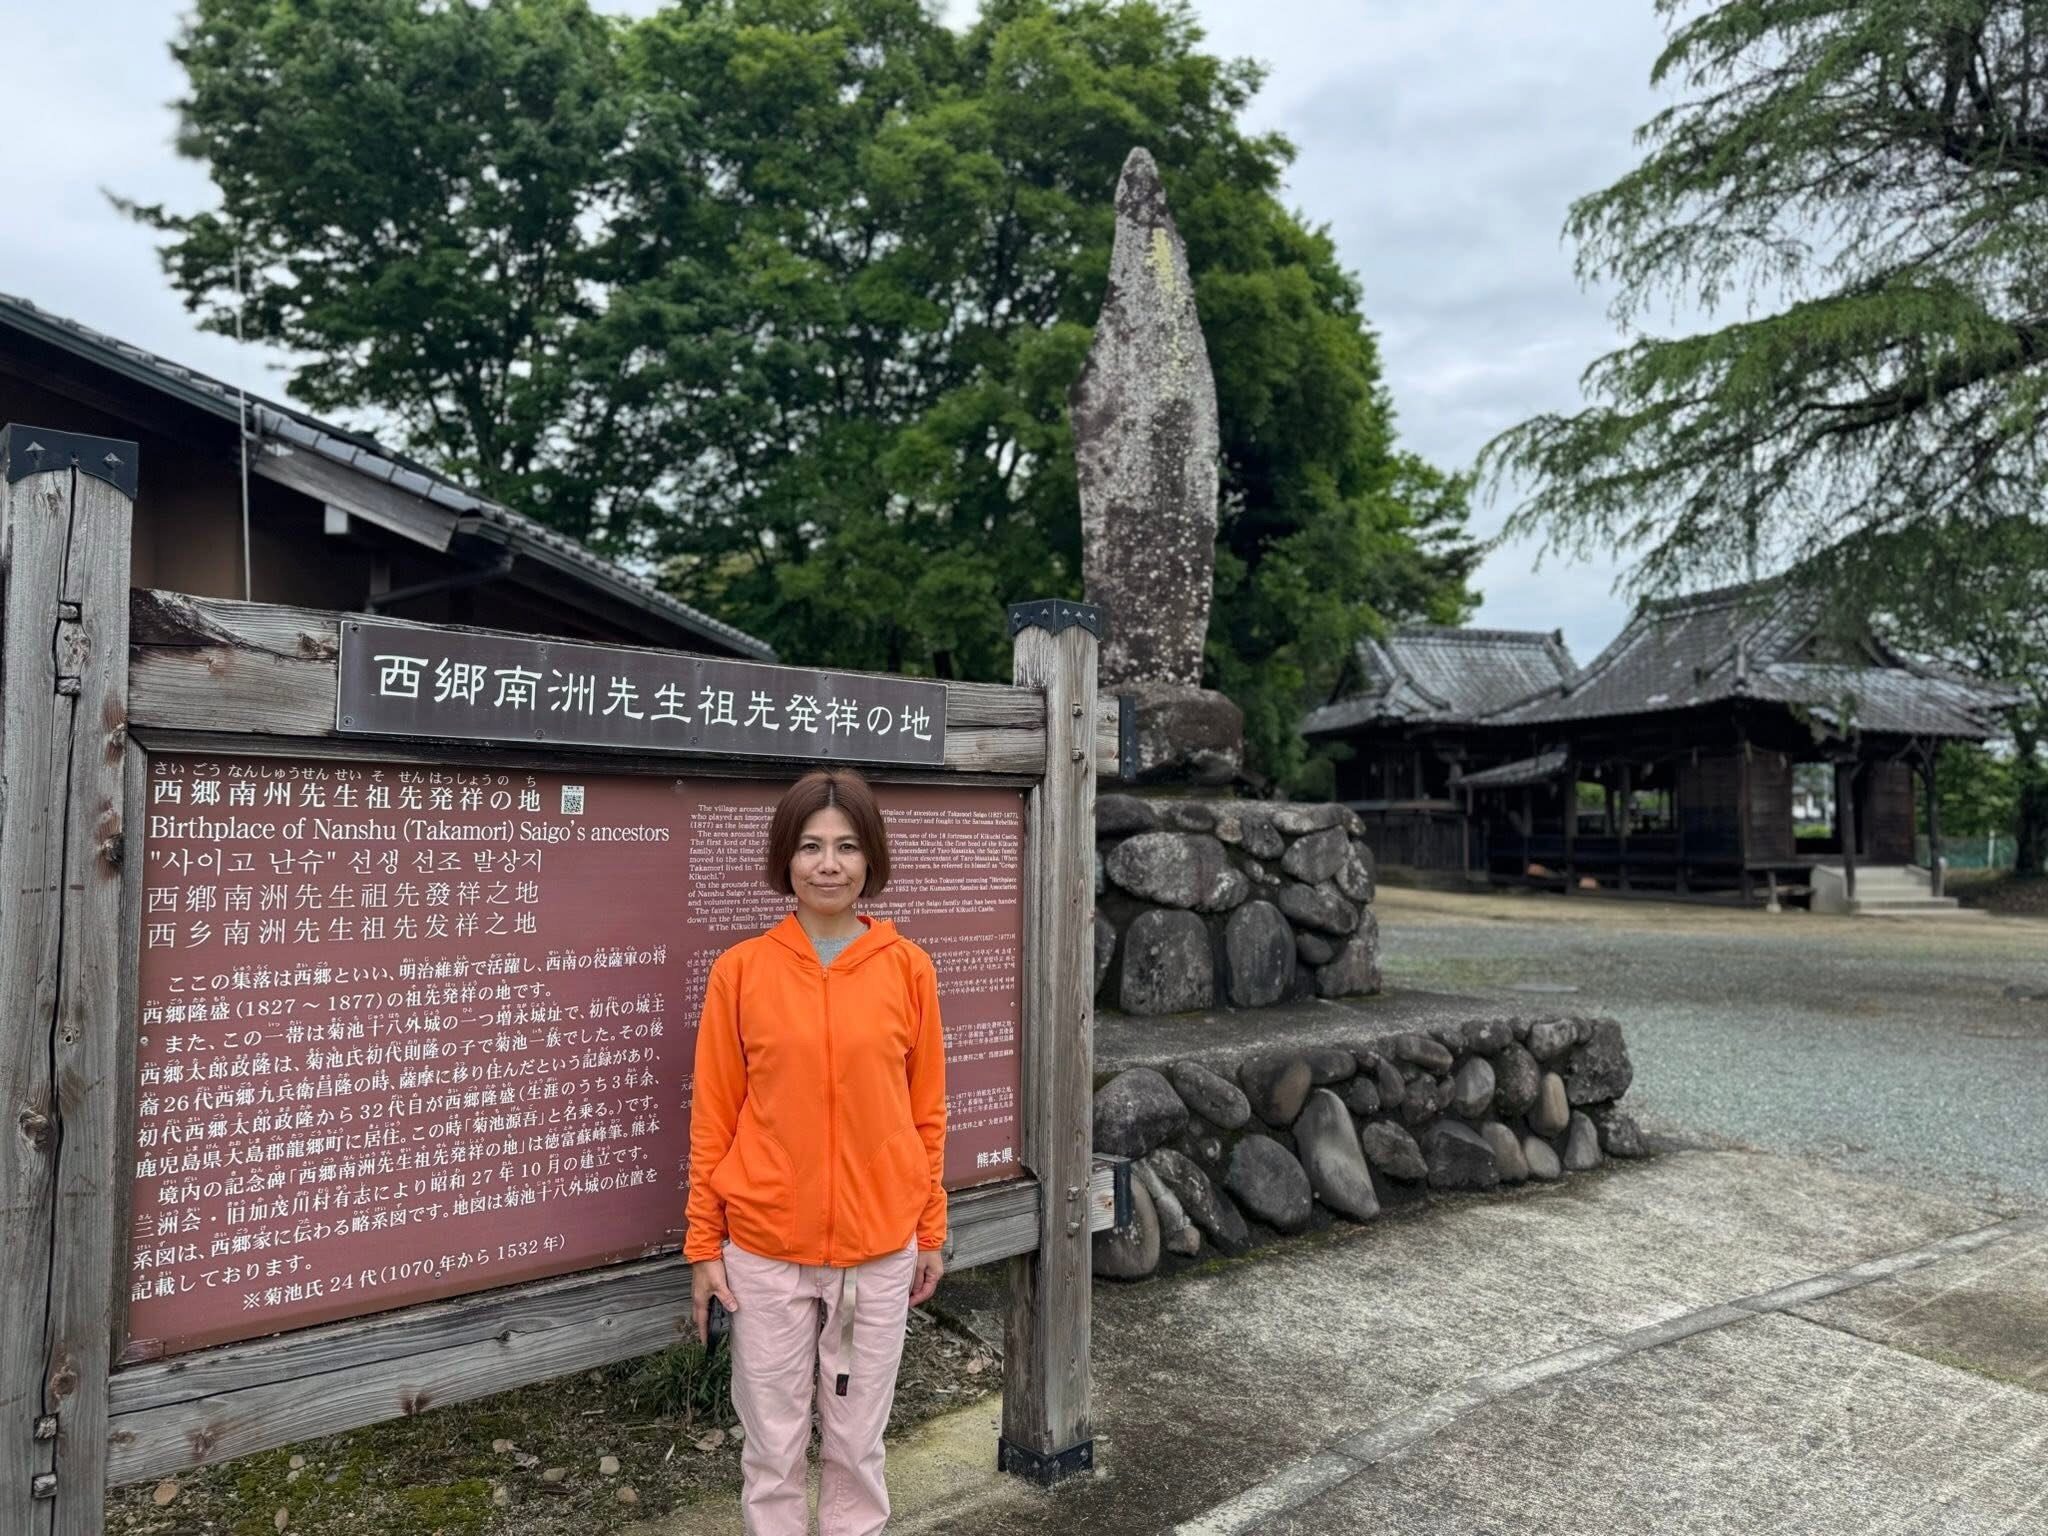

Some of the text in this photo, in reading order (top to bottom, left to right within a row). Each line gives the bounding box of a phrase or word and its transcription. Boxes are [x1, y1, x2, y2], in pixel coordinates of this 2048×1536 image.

[373, 653, 933, 744] 西郷南洲先生祖先発祥の地
[153, 779, 541, 812] 西郷南州先生祖先発祥の地
[150, 816, 275, 842] Birthplace
[283, 818, 306, 840] of
[313, 818, 396, 840] Nanshu
[403, 820, 514, 843] (Takamori)
[590, 824, 670, 841] ancestors
[151, 848, 543, 876] "사이고 난슈" 선생 선조 발상지
[147, 911, 537, 949] 西乡南洲先生祖先发祥之地
[976, 1147, 1013, 1169] 熊本県
[131, 1254, 313, 1302] 記載しております。
